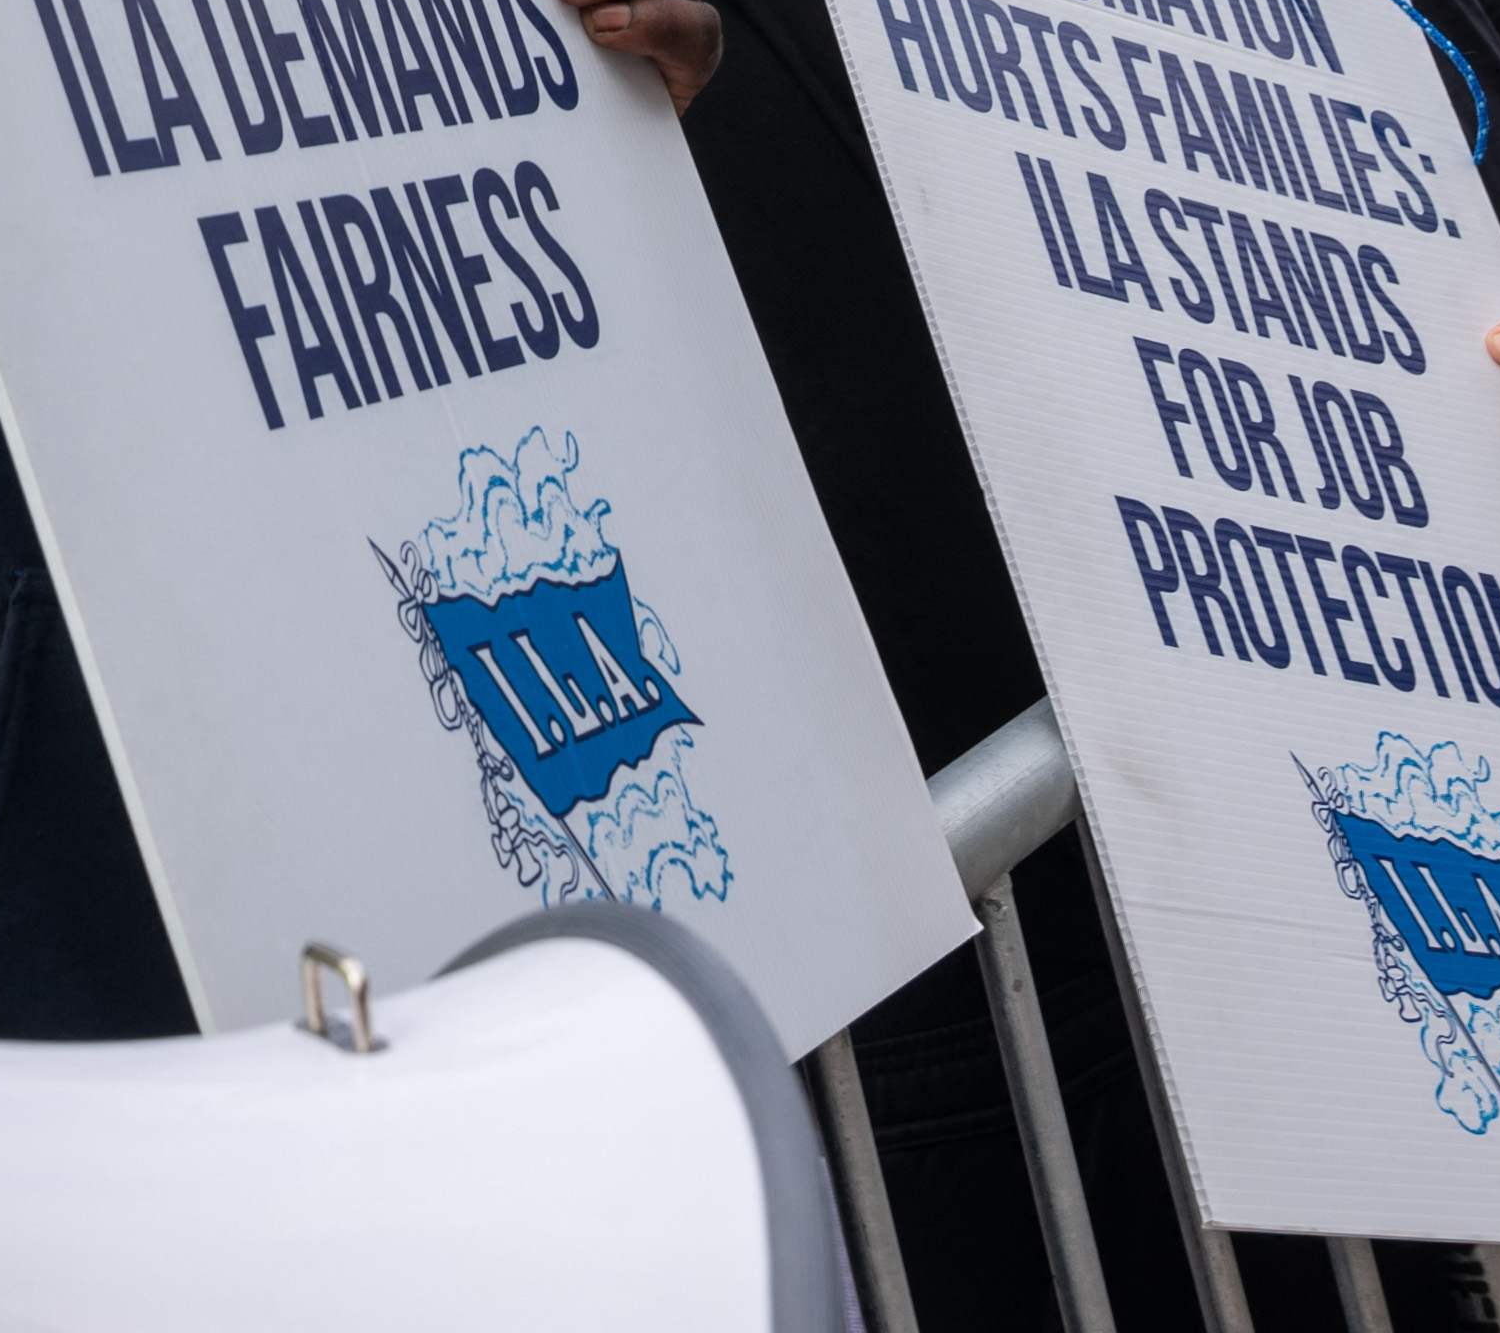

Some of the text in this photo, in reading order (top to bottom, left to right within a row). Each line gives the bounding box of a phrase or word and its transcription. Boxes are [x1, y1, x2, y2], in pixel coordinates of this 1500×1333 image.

[1114, 31, 1462, 241] FAMILIES:
[200, 159, 601, 431] FAIRNESS
[1016, 151, 1428, 377] ILA STANDS
[1132, 336, 1431, 527] FOR JOB
[476, 598, 660, 775] I.L.A.
